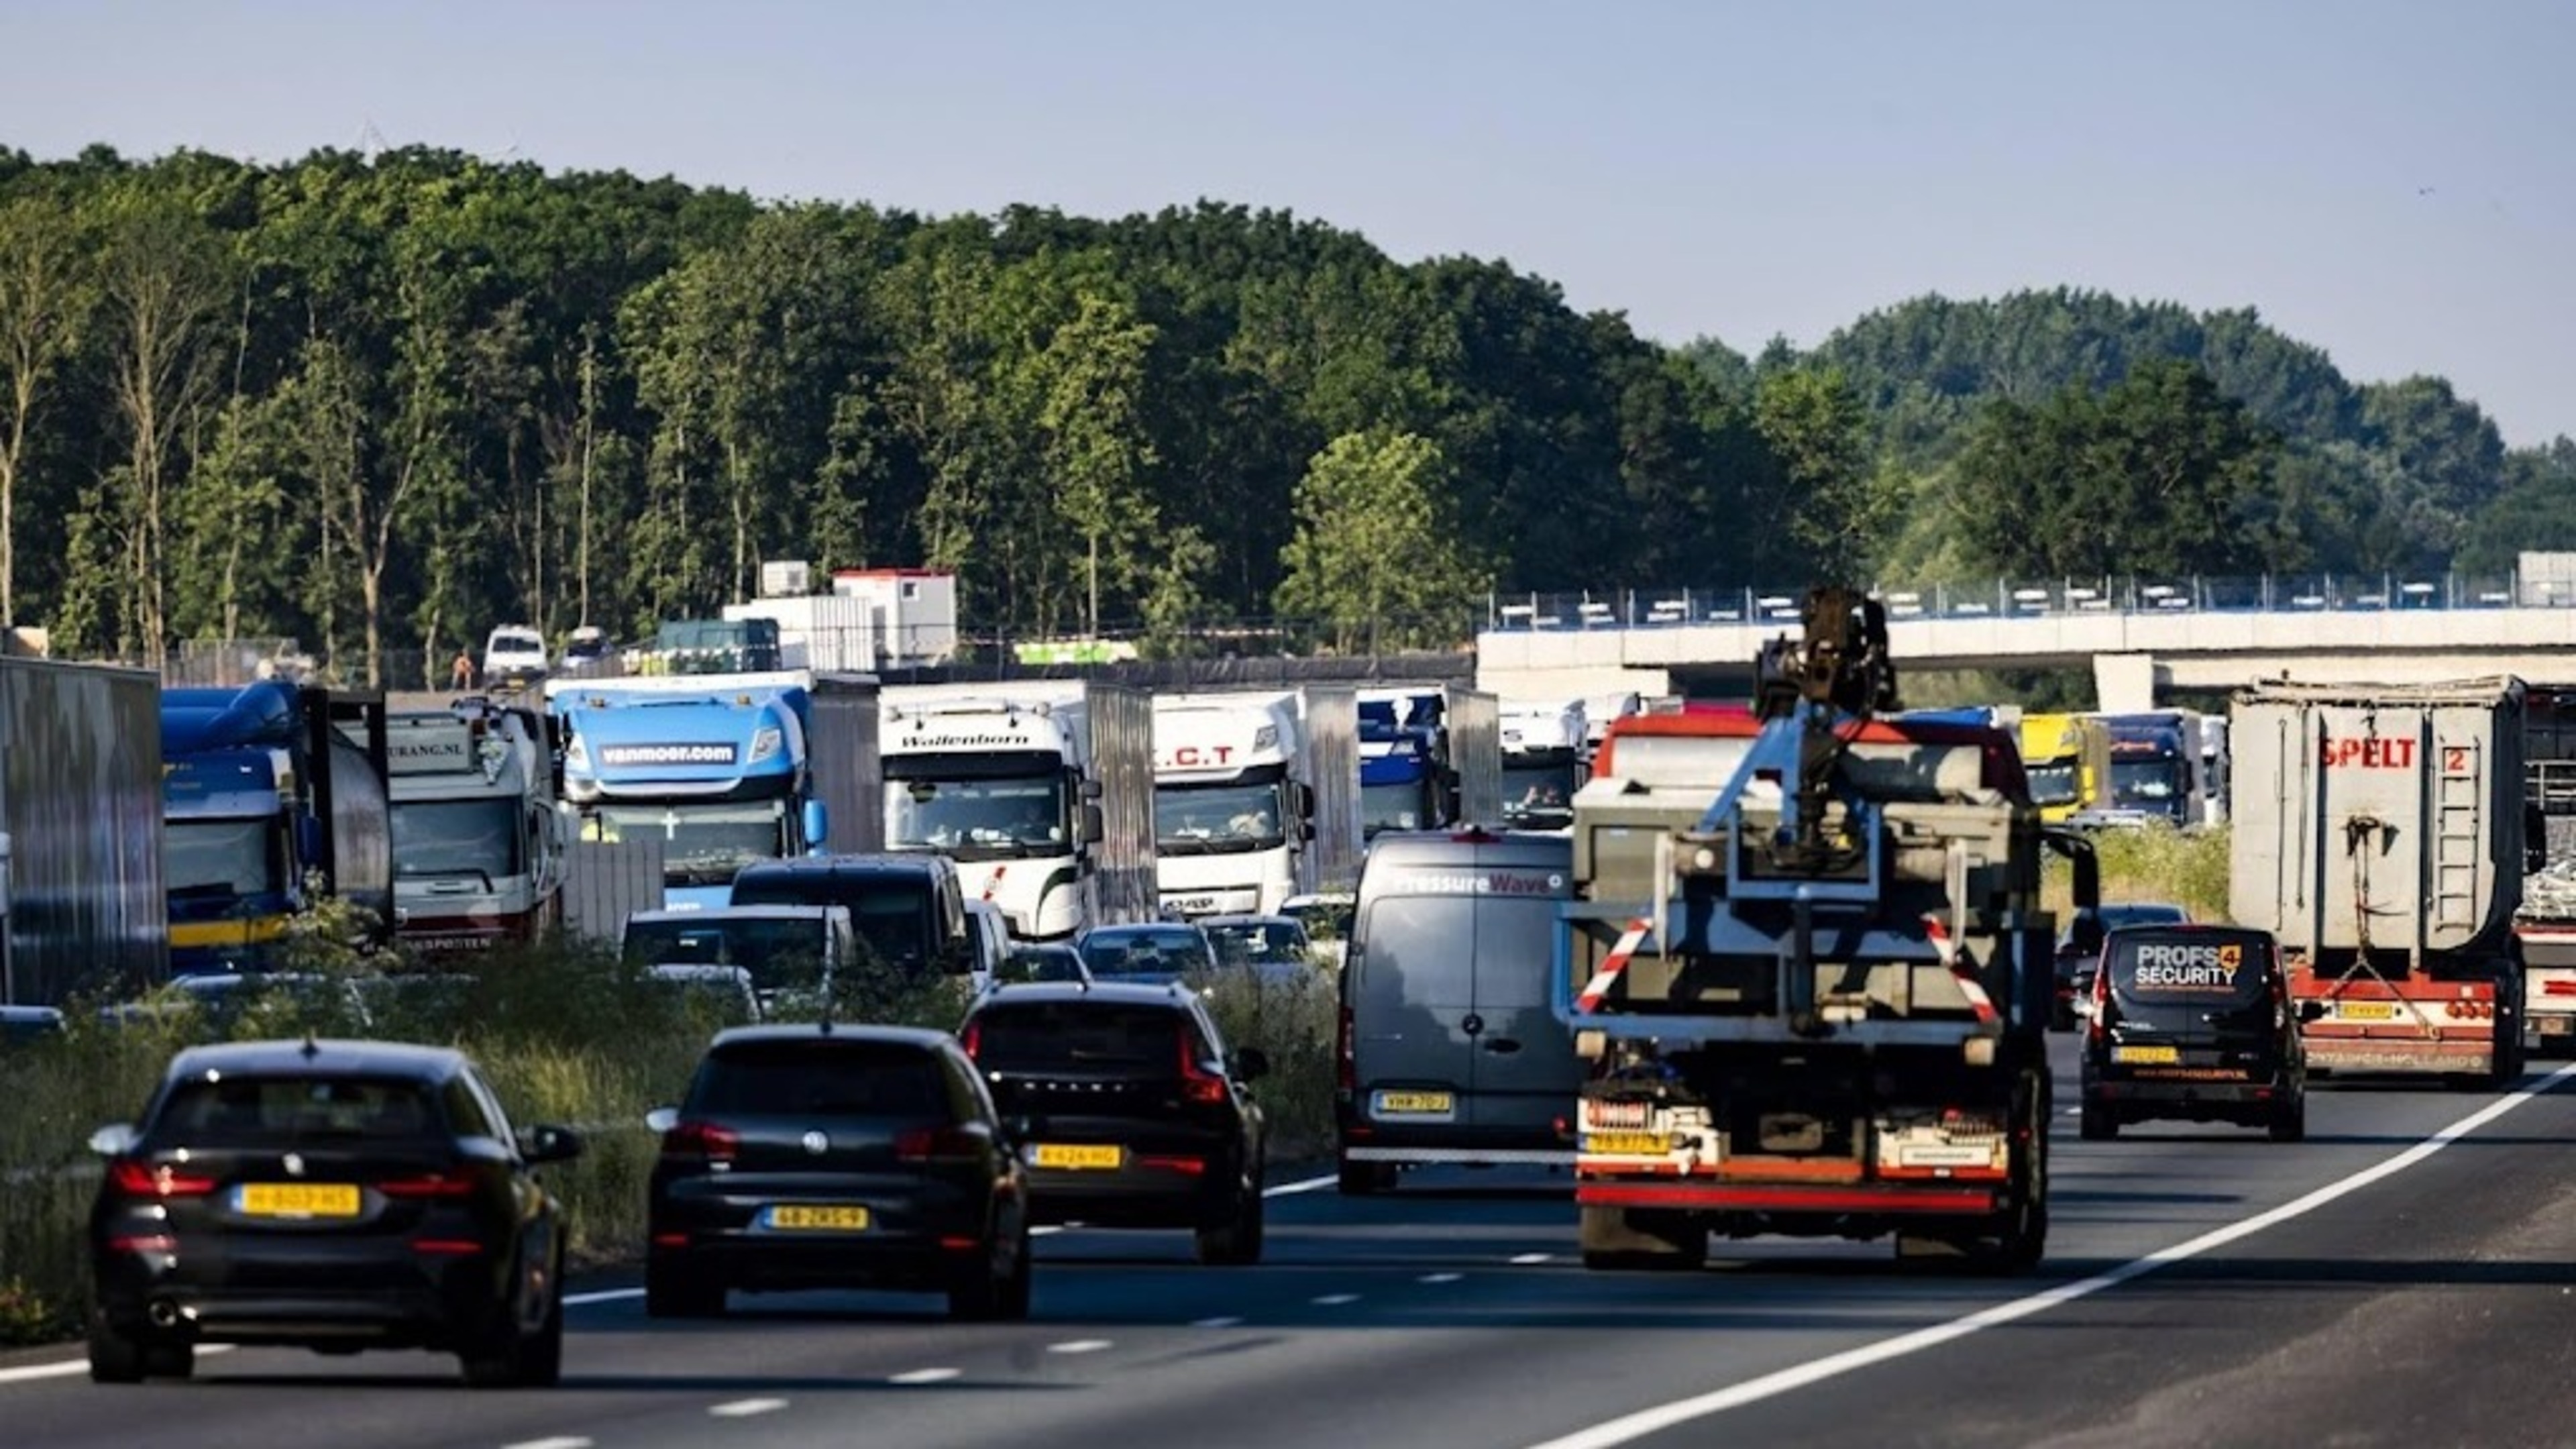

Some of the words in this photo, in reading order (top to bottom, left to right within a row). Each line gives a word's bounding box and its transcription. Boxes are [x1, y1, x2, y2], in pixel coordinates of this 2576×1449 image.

[903, 735, 1028, 748] Wallenborn
[603, 746, 733, 763] vanmoer.com
[1152, 746, 1233, 765] .C.T
[2322, 739, 2415, 768] SPELT
[2448, 749, 2465, 771] 2
[2135, 967, 2237, 984] SECURITY
